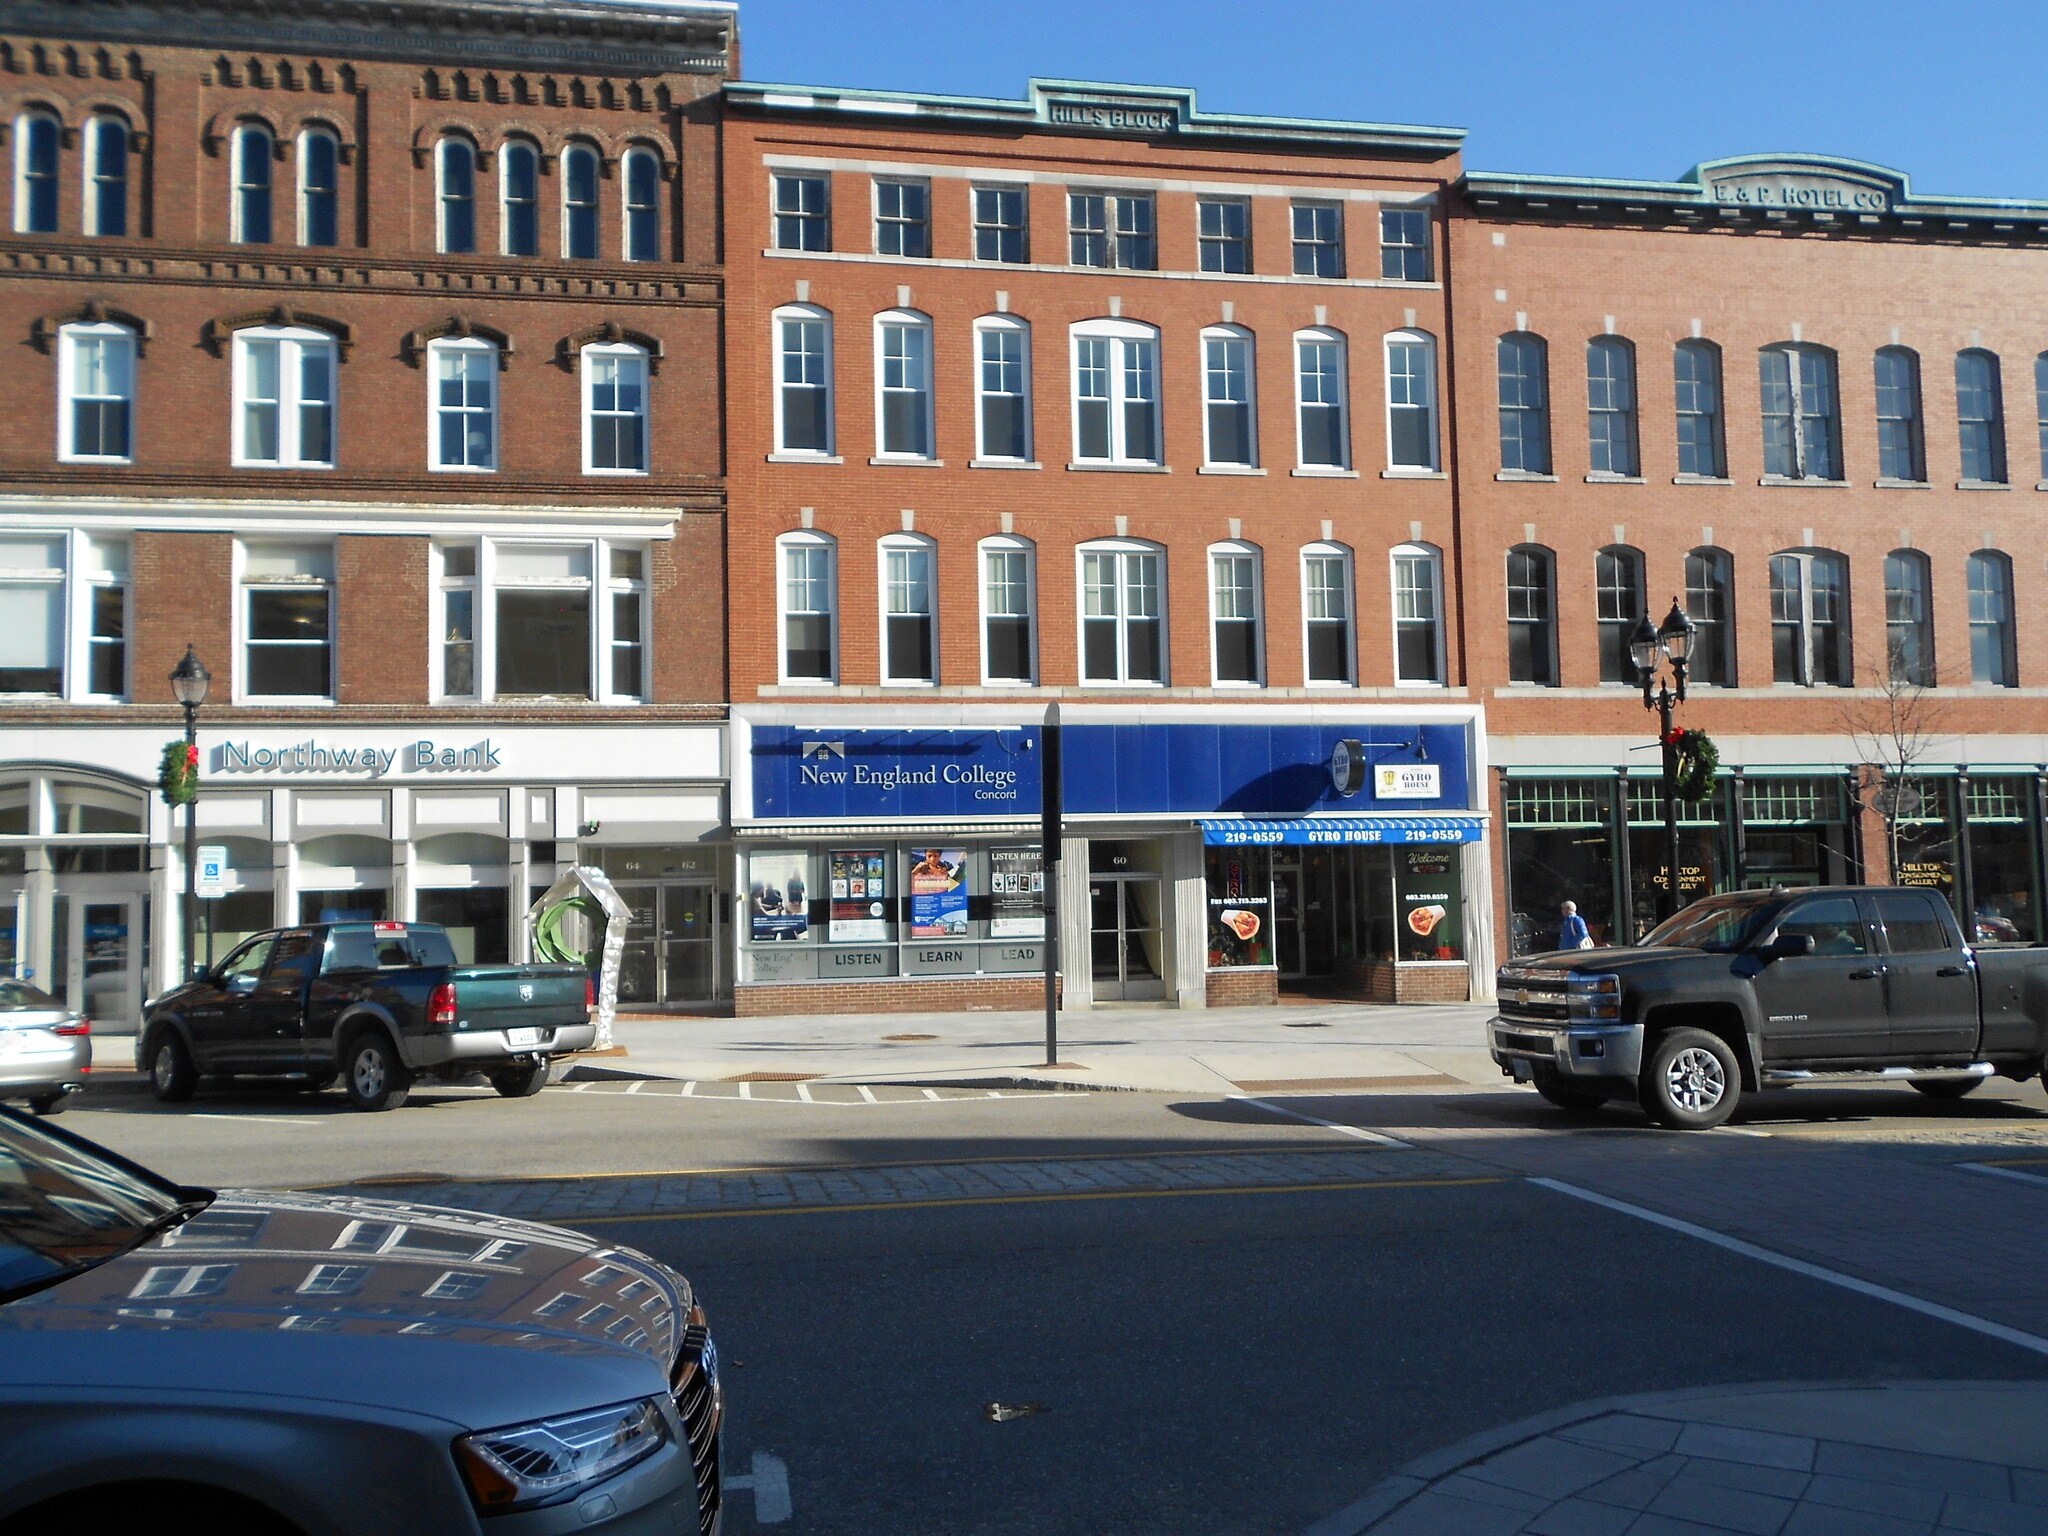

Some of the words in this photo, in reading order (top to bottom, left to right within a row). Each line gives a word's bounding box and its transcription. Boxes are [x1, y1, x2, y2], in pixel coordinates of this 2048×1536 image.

[1110, 109, 1172, 129] BLOCK
[1736, 187, 1750, 202] &
[1783, 187, 1849, 207] HOTEL
[221, 738, 397, 774] Northway
[415, 738, 501, 767] Bank
[800, 765, 848, 785] New
[853, 764, 937, 790] England
[943, 764, 1017, 789] College
[1401, 773, 1432, 782] GYRO
[974, 789, 1017, 800] Concord
[1225, 831, 1284, 843] 219-0559
[1308, 831, 1341, 842] GYRO
[1345, 830, 1382, 841] HOUSE
[1405, 829, 1463, 841] 219-0559
[992, 852, 1019, 860] LISTEN
[1020, 852, 1042, 860] HERE
[1113, 857, 1127, 865] 60
[1408, 852, 1450, 864] Welcome
[626, 862, 640, 870] 64
[682, 861, 696, 869] 62
[1661, 866, 1701, 875] HTOP
[1904, 878, 1938, 886] GALLERY
[752, 953, 771, 962] New
[773, 952, 808, 964] Engd
[835, 953, 882, 965] LISTEN
[919, 951, 963, 963] LEARN
[1001, 949, 1035, 960] LEAD
